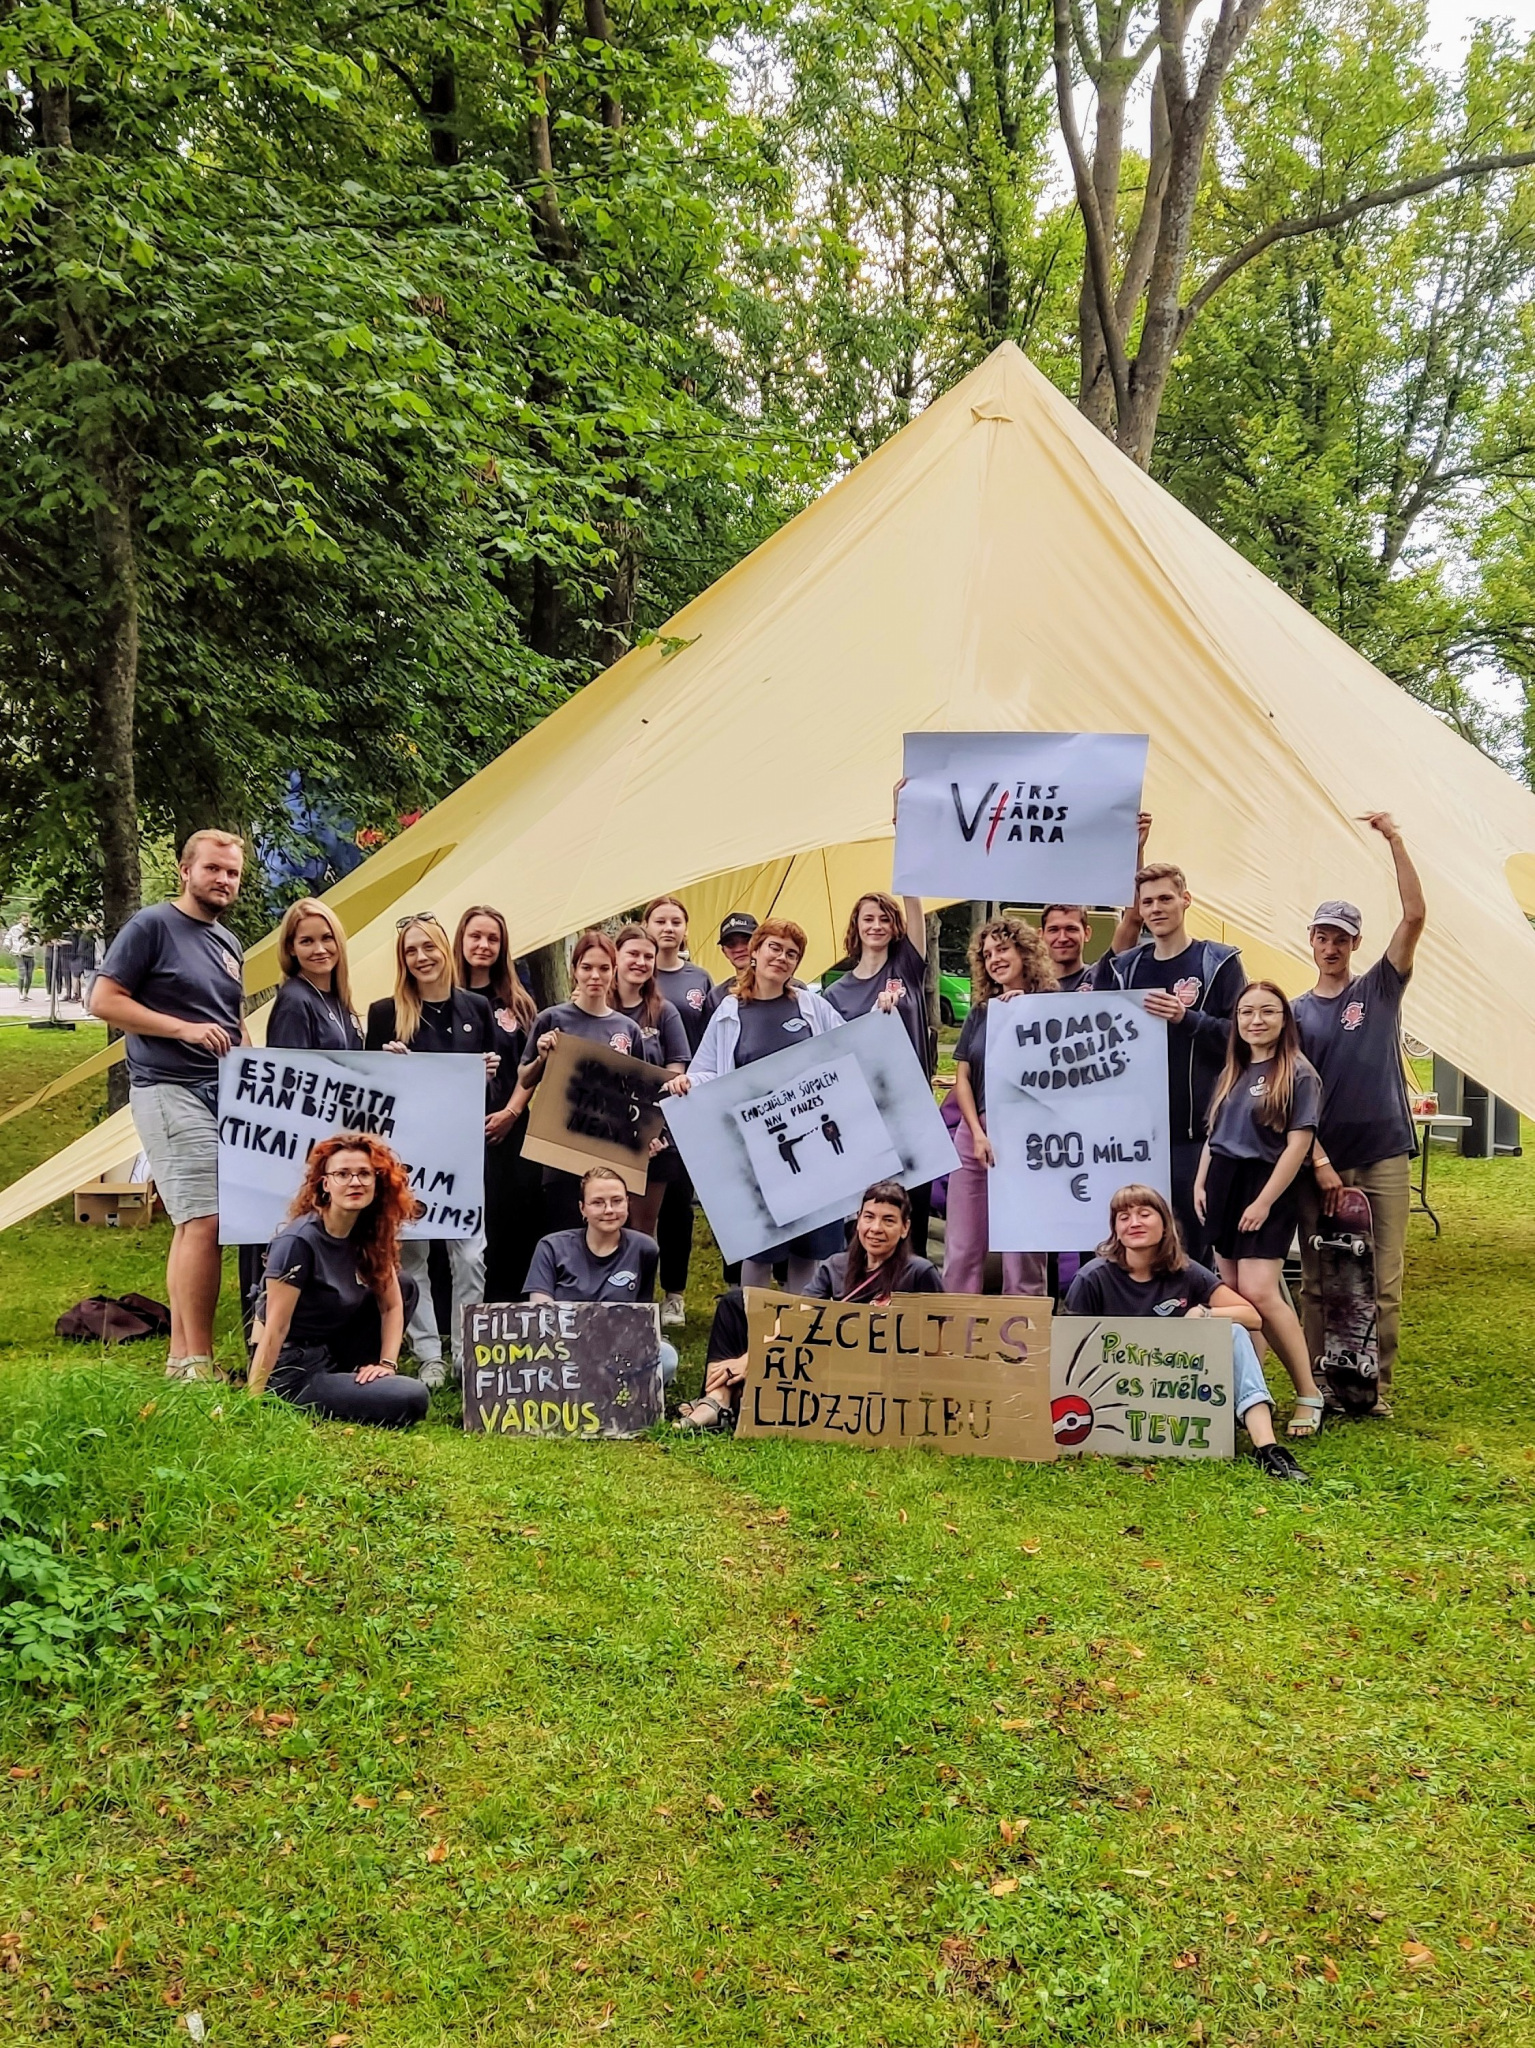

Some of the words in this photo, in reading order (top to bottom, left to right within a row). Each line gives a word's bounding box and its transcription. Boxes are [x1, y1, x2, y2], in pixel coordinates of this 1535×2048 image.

[1010, 802, 1069, 821] ĀRDS
[1007, 824, 1064, 843] ARA
[240, 1058, 276, 1084] ES
[236, 1080, 295, 1111] MAN
[342, 1107, 396, 1139] VARA
[764, 1112, 782, 1128] NAV
[790, 1094, 824, 1117] PAUZES
[1026, 1131, 1084, 1171] 800
[763, 1302, 1034, 1365] IZCELIES
[474, 1341, 570, 1367] DOMAS
[1116, 1378, 1144, 1398] es
[479, 1398, 600, 1433] VĀRDUS
[1125, 1410, 1211, 1448] TEVI
